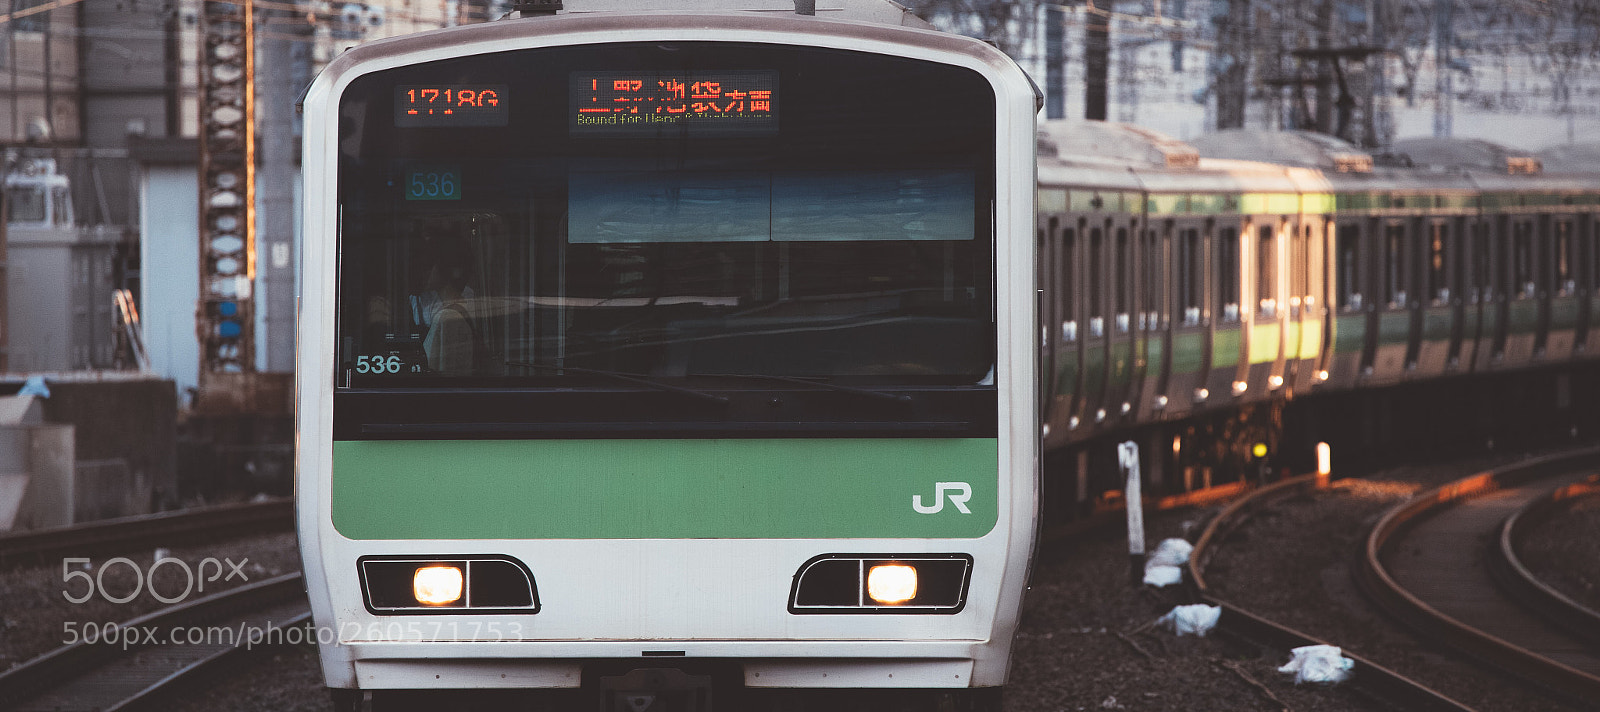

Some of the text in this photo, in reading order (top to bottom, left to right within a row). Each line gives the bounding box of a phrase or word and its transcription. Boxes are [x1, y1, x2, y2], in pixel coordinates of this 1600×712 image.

[577, 113, 617, 125] Bound
[411, 172, 454, 197] 536
[356, 355, 401, 374] 536
[912, 481, 972, 514] JR
